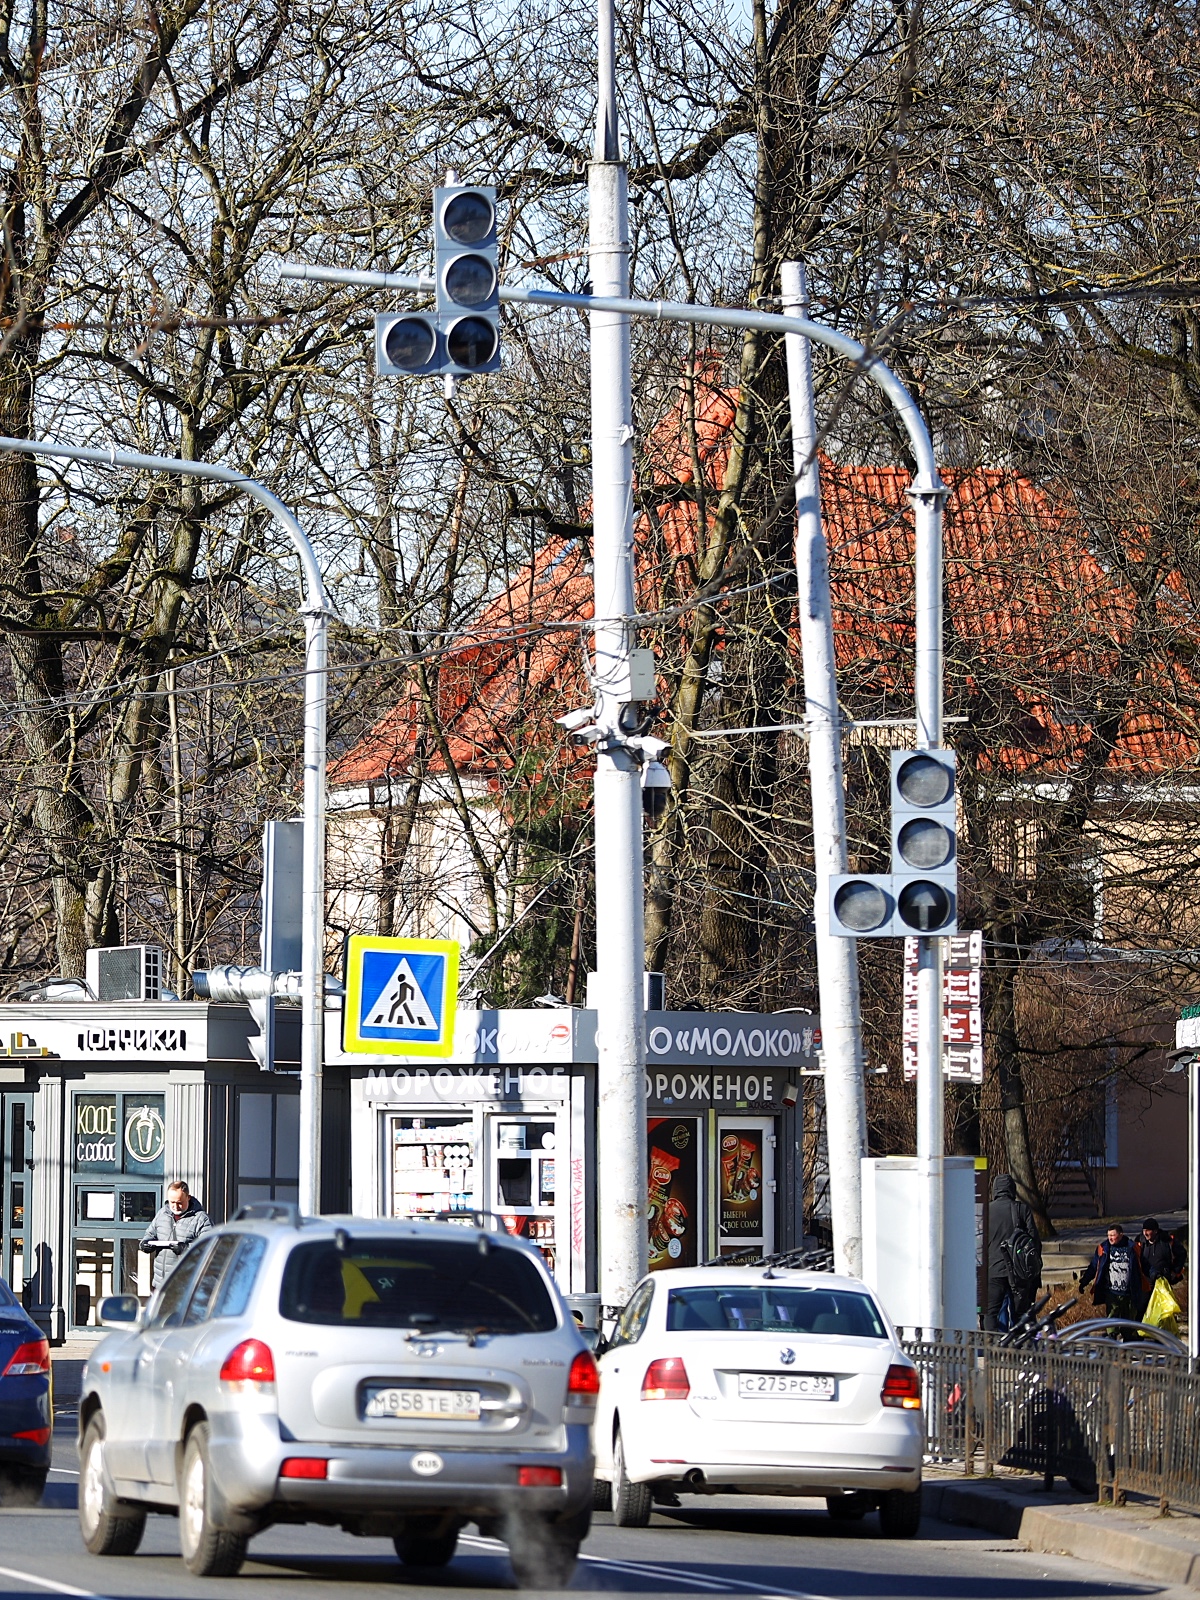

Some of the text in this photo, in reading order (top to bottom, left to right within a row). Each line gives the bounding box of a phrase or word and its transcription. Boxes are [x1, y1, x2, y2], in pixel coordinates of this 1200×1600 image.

[675, 1027, 801, 1057] «МОЛОКО»
[365, 1066, 565, 1096] МОРОЖЕНОЕ
[77, 1105, 116, 1135] КОФЕ
[723, 1211, 747, 1219] ВЫБЕРИ
[723, 1220, 739, 1229] СВОЕ
[813, 1376, 828, 1389] 39
[456, 1394, 473, 1408] 39
